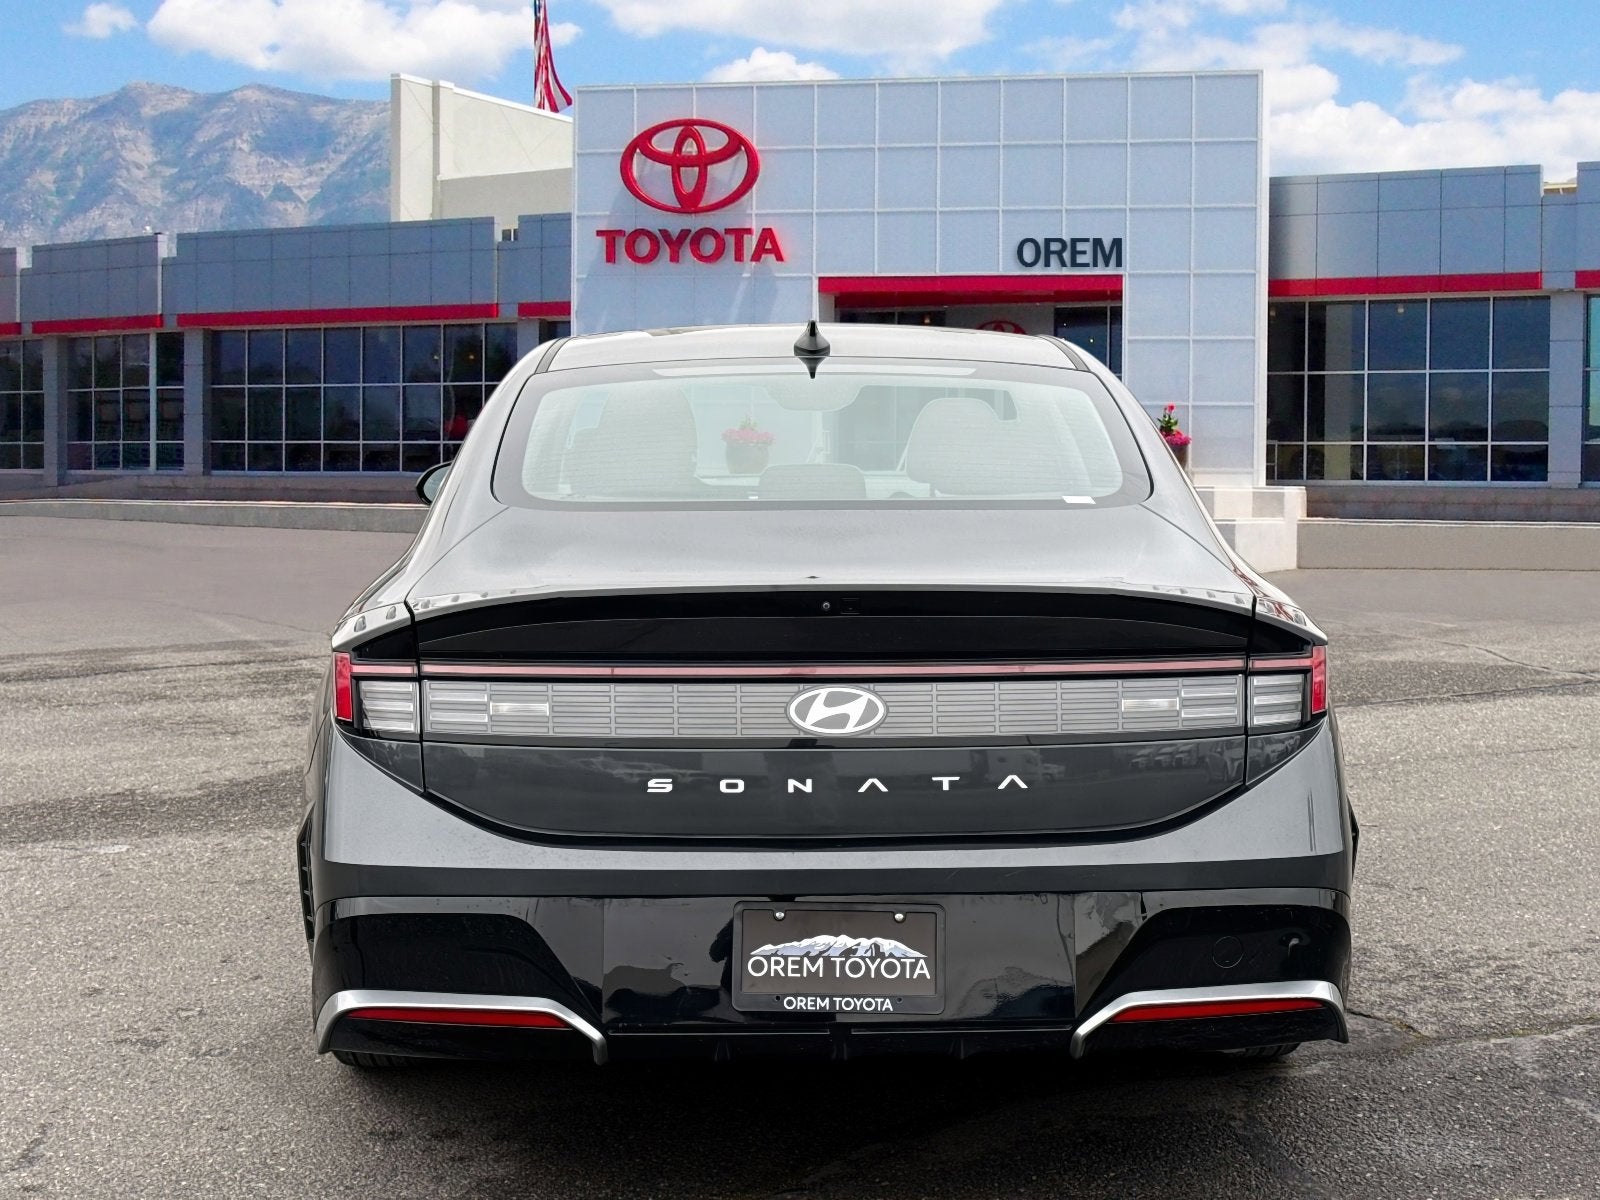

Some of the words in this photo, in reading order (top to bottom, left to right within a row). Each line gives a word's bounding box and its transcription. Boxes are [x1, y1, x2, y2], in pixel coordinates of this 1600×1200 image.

[595, 226, 785, 264] TOYOTA
[1016, 237, 1123, 268] OREM
[646, 775, 1029, 793] SONATA
[747, 956, 823, 977] OREM
[830, 957, 931, 979] TOYOTA
[783, 996, 830, 1010] OREM
[833, 997, 893, 1011] TOYOTA
